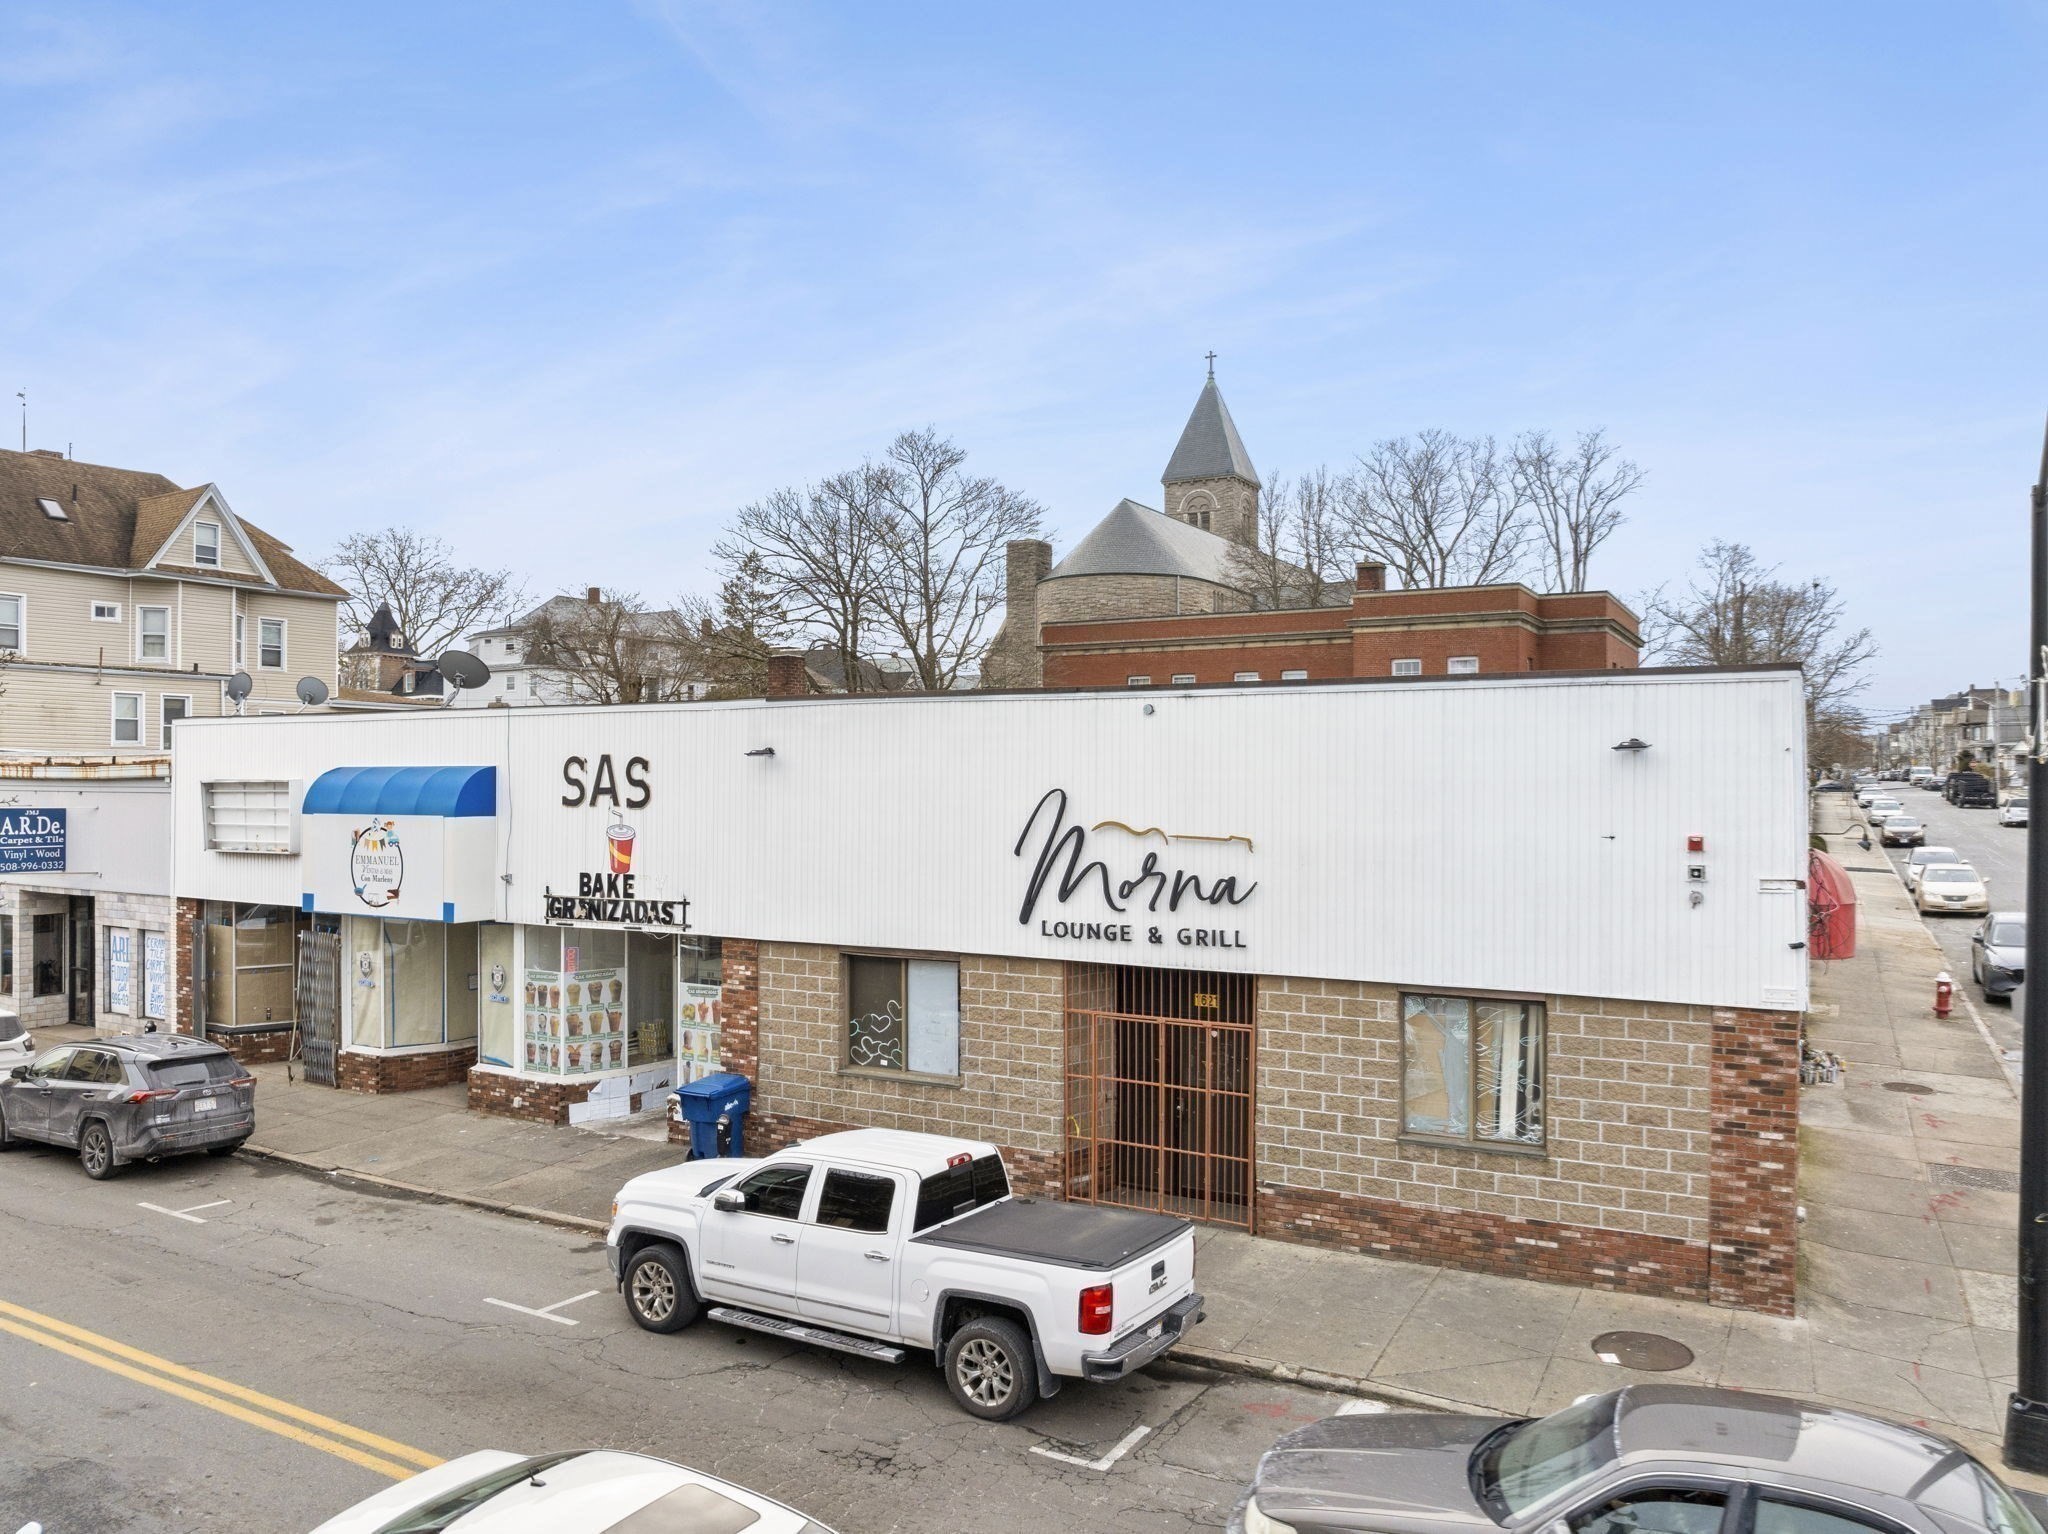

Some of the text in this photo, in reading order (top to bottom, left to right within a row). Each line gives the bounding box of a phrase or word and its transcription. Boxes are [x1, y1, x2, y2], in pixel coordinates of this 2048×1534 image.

[561, 754, 651, 809] SAS
[0, 835, 65, 845] Carpet & Tile
[4, 848, 61, 861] Vinyl Wood
[355, 855, 399, 866] EMMANUEL
[1014, 788, 1258, 925] Morna
[0, 860, 64, 871] 508-996-0332
[579, 872, 636, 899] BAKE
[1041, 919, 1247, 949] LOUNGE & GRILL
